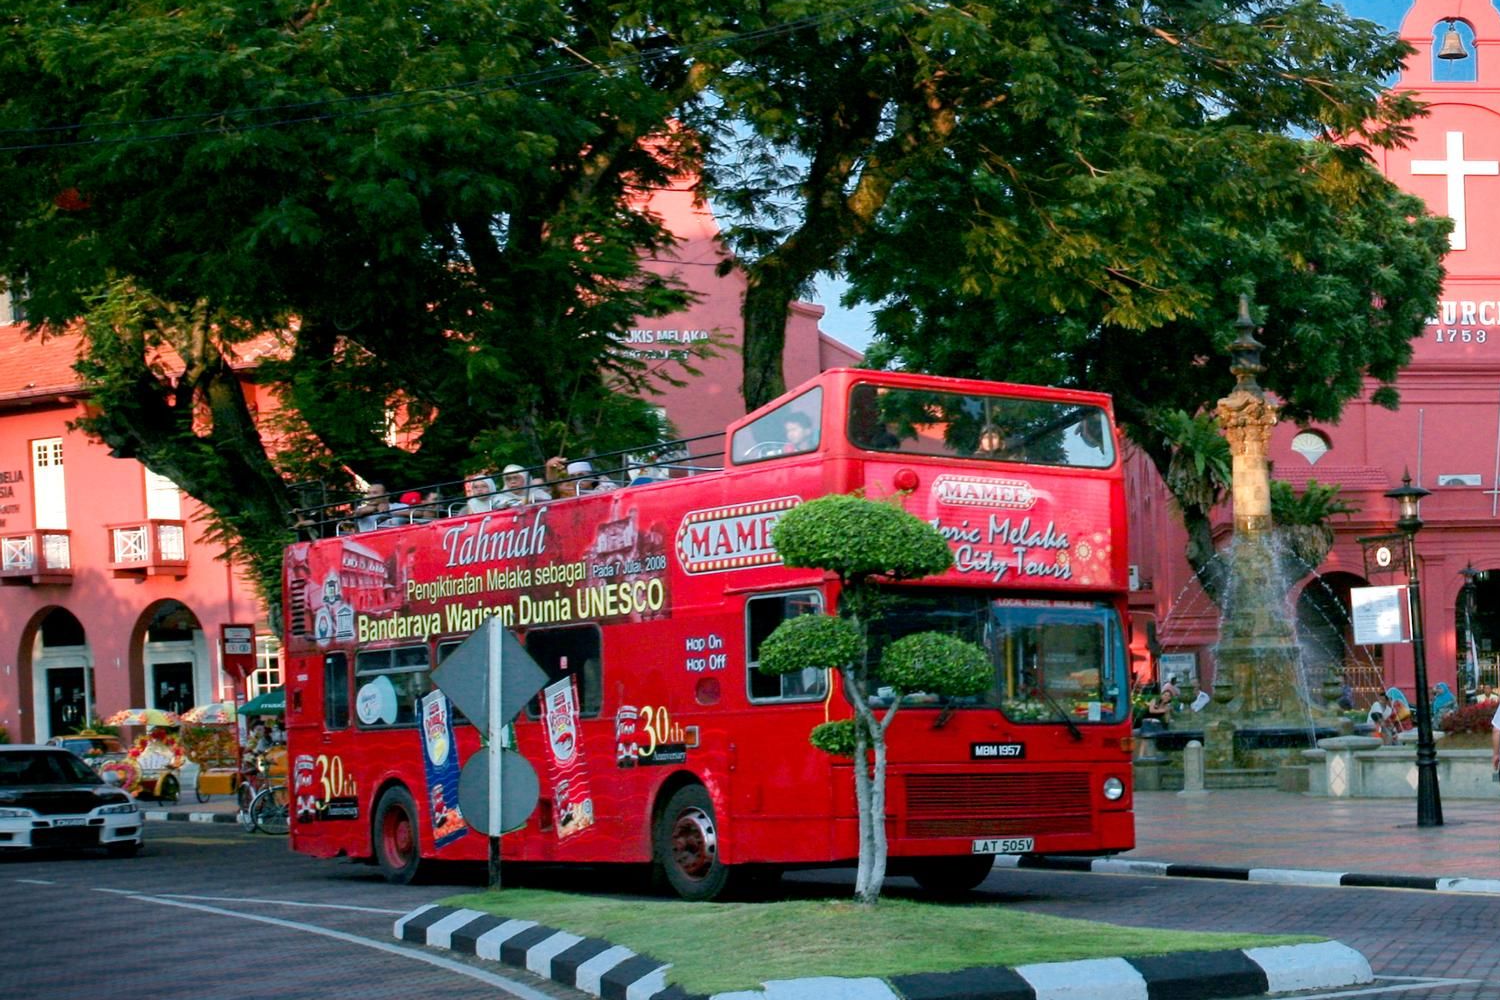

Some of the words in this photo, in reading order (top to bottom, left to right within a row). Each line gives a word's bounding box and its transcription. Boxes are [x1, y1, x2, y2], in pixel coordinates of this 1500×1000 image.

[1435, 329, 1487, 343] 1753
[943, 482, 1027, 503] MAMEE
[442, 506, 547, 568] Tahniah
[690, 515, 779, 559] MAME
[988, 513, 1070, 549] Melaka
[592, 565, 614, 578] Pada
[615, 562, 620, 572] 7
[645, 555, 666, 571] 2008
[954, 544, 1008, 583] City
[1013, 547, 1072, 580] Tours
[407, 572, 483, 604] Pengiktirafan
[486, 565, 531, 591] Melaka
[535, 561, 586, 587] sebagai
[358, 612, 441, 643] Bandaraya
[519, 591, 571, 625] Dunia
[577, 578, 664, 618] UNESCO
[686, 638, 705, 652] Hop
[708, 634, 722, 649] On
[686, 658, 706, 672] Hop
[709, 654, 727, 671] Off
[975, 745, 998, 756] MBM
[999, 745, 1021, 756] 1957
[973, 841, 998, 853] LAT
[1002, 840, 1033, 852] 505V
